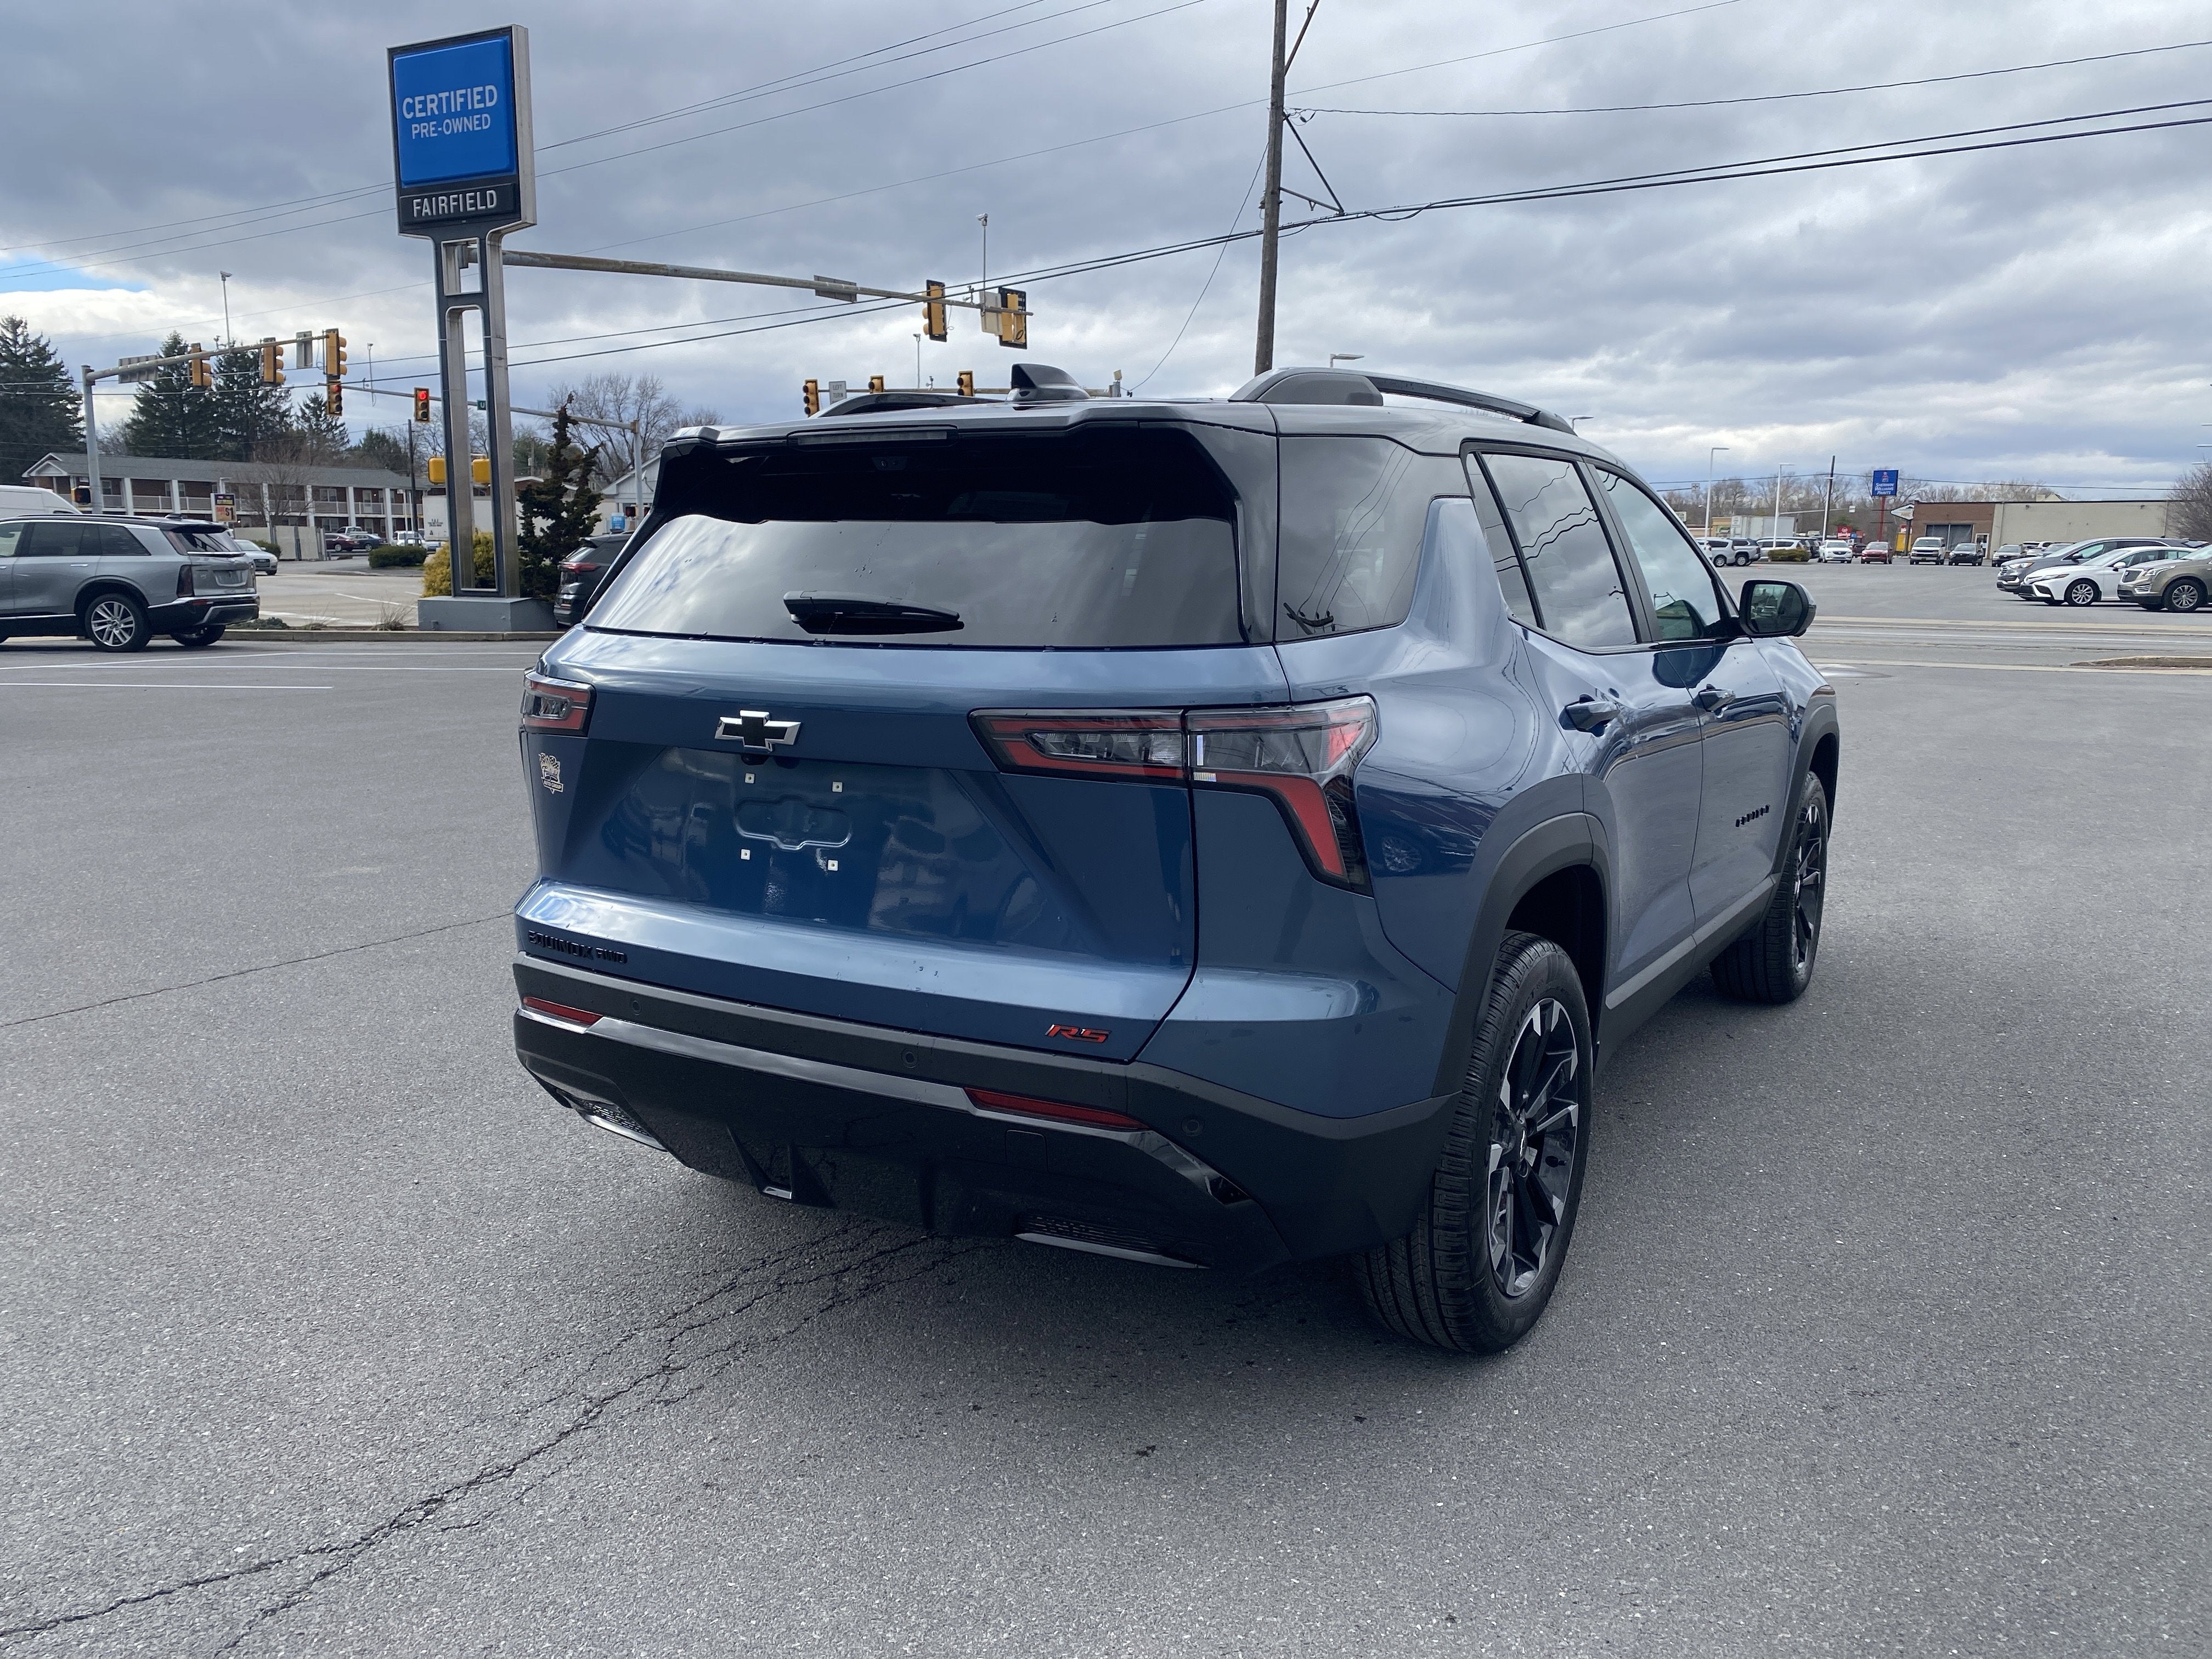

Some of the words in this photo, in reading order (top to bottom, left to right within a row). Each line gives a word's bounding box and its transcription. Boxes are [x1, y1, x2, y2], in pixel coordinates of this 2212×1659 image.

[402, 84, 498, 119] CERTIFIED
[412, 113, 490, 139] PRE-OWNED
[413, 190, 496, 217] FAIRFIELD
[528, 930, 594, 960] EQUINOX
[1045, 1024, 1112, 1043] RS
